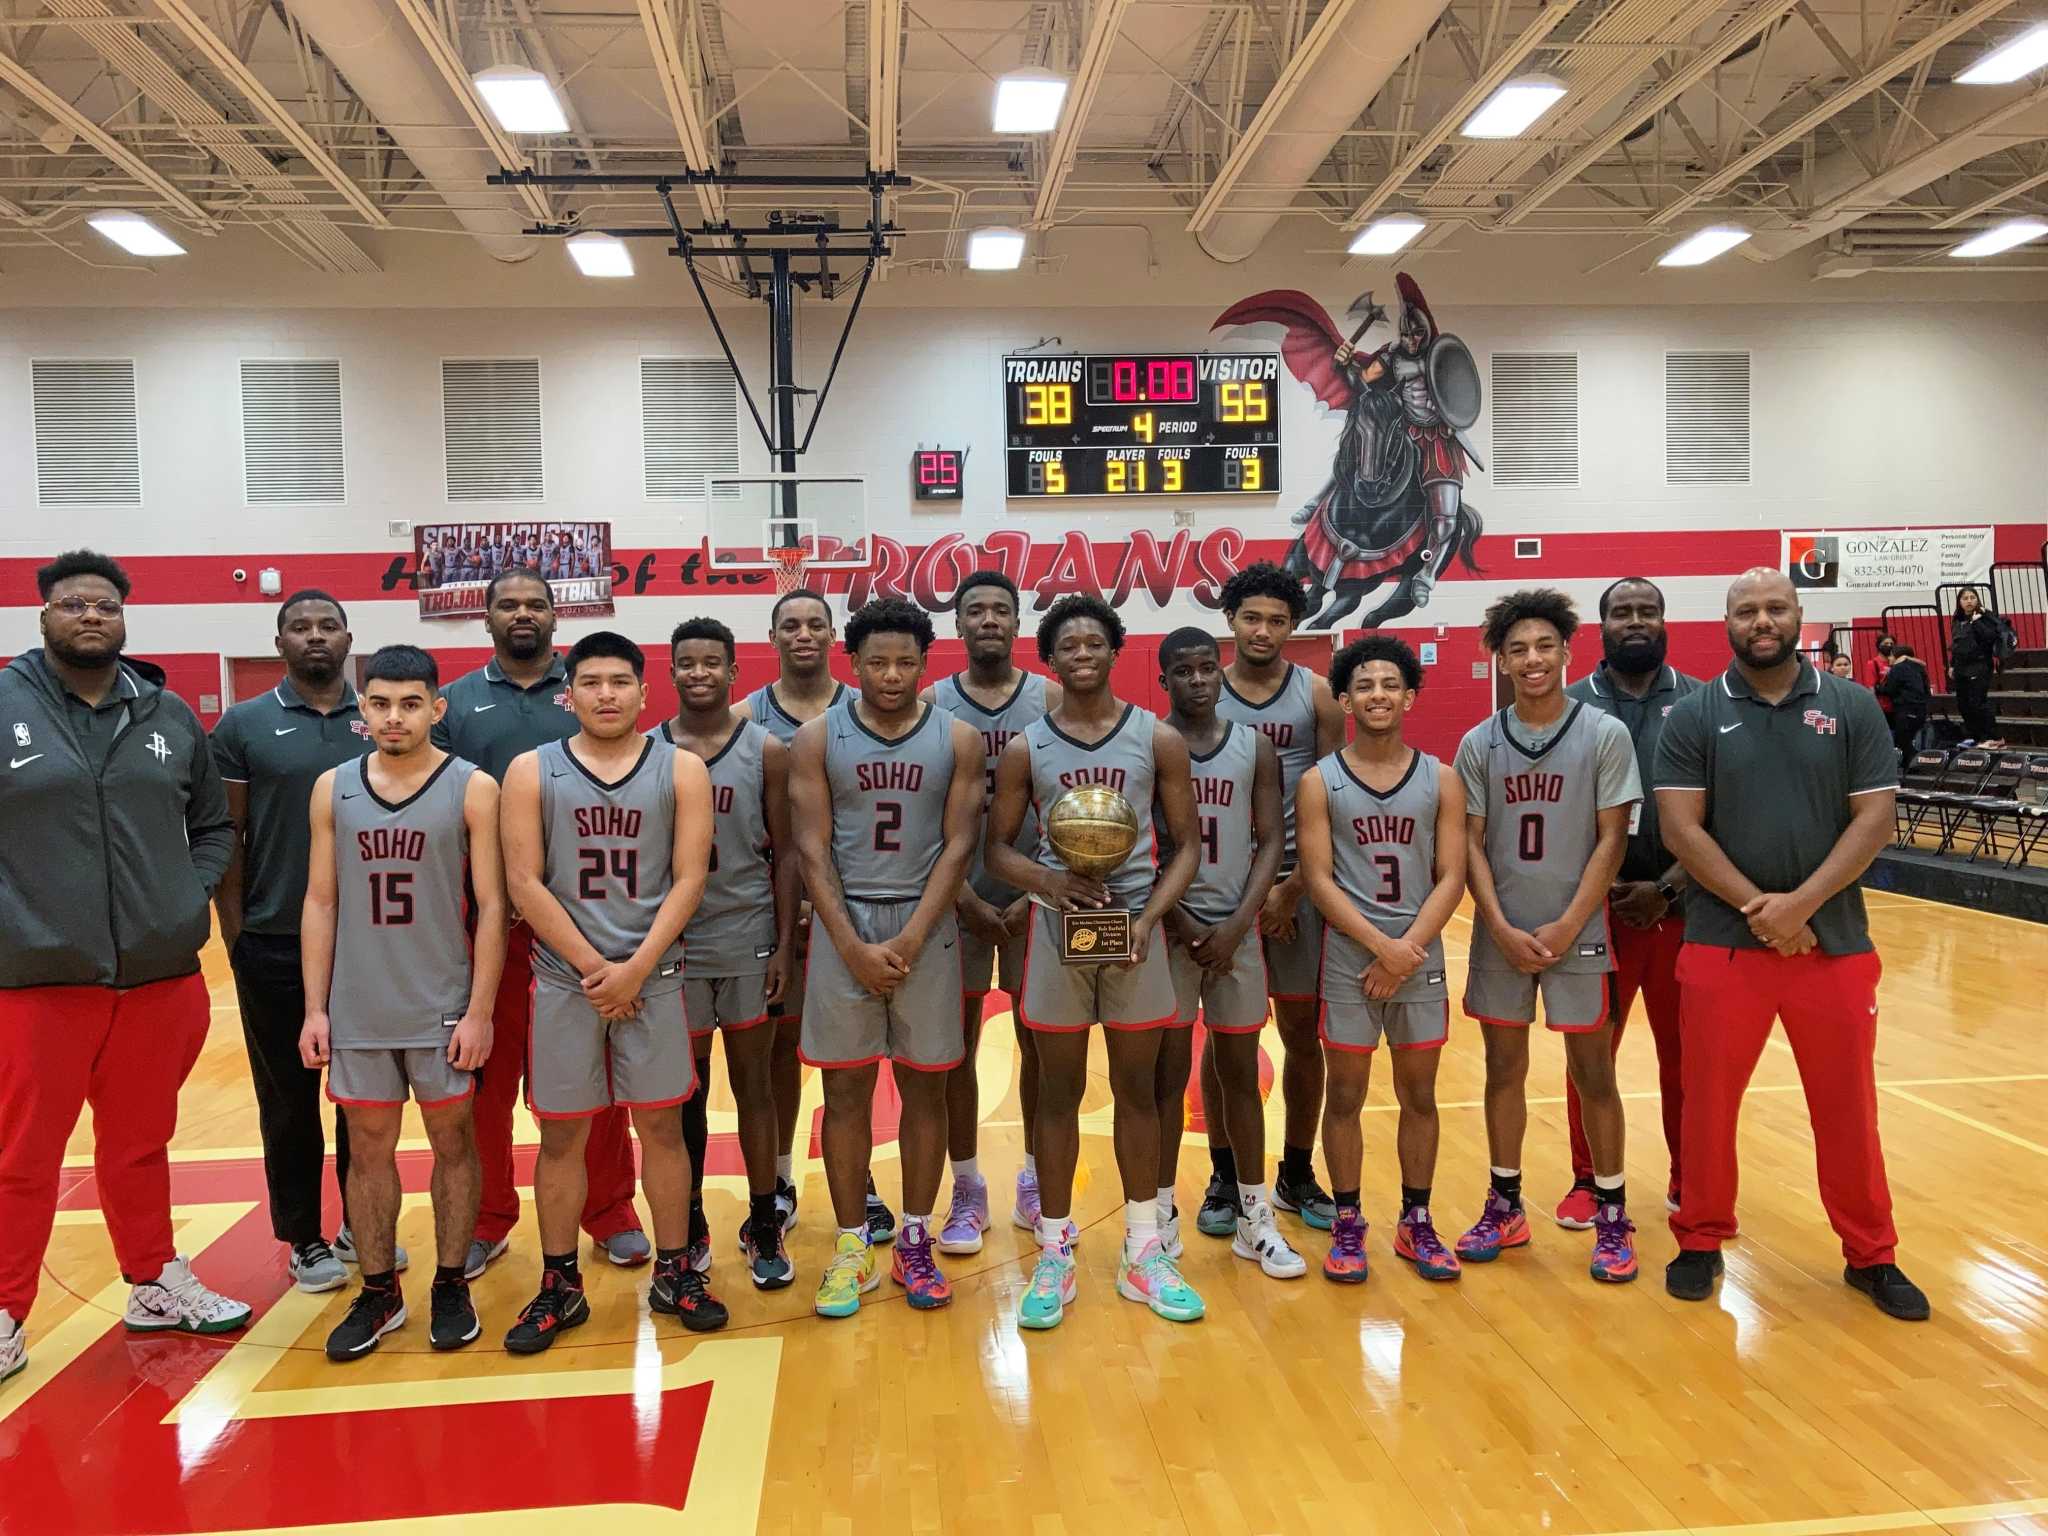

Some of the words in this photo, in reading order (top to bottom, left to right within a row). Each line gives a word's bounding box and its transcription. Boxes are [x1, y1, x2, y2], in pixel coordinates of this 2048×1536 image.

[1007, 361, 1082, 382] TROJANS
[1200, 358, 1278, 381] VISITOR
[1025, 385, 1071, 425] 38
[1221, 383, 1267, 422] 55
[1092, 425, 1128, 433] SPECTRUM
[1133, 412, 1153, 443] 4
[1159, 421, 1198, 433] PERIOD
[1029, 450, 1063, 463] FOULS
[1106, 450, 1145, 461] PLAYER
[1158, 448, 1191, 460] FOULS
[1225, 447, 1258, 459] FOULS
[920, 454, 957, 484] 25
[1046, 462, 1065, 493] 5
[1163, 460, 1182, 491] 3
[1242, 459, 1260, 490] 3
[423, 526, 495, 551] SOUTH
[503, 523, 604, 549] HOUSTON
[1846, 540, 1928, 553] GONZALEZ
[797, 527, 1247, 613] TROJANS
[1799, 548, 1827, 579] G
[1854, 564, 1924, 576] 832-530-4070
[550, 580, 608, 602] ETBALL
[856, 761, 924, 793] SOHO
[1191, 776, 1234, 807] OHO
[1504, 773, 1564, 804] SOHO
[573, 806, 642, 838] SOHO
[873, 802, 902, 852] 2
[1353, 815, 1416, 846] SOHO
[1518, 813, 1545, 862] 0
[358, 828, 427, 862] SOHO
[578, 848, 638, 900] 24
[1374, 855, 1401, 904] 3
[368, 872, 414, 926] 15
